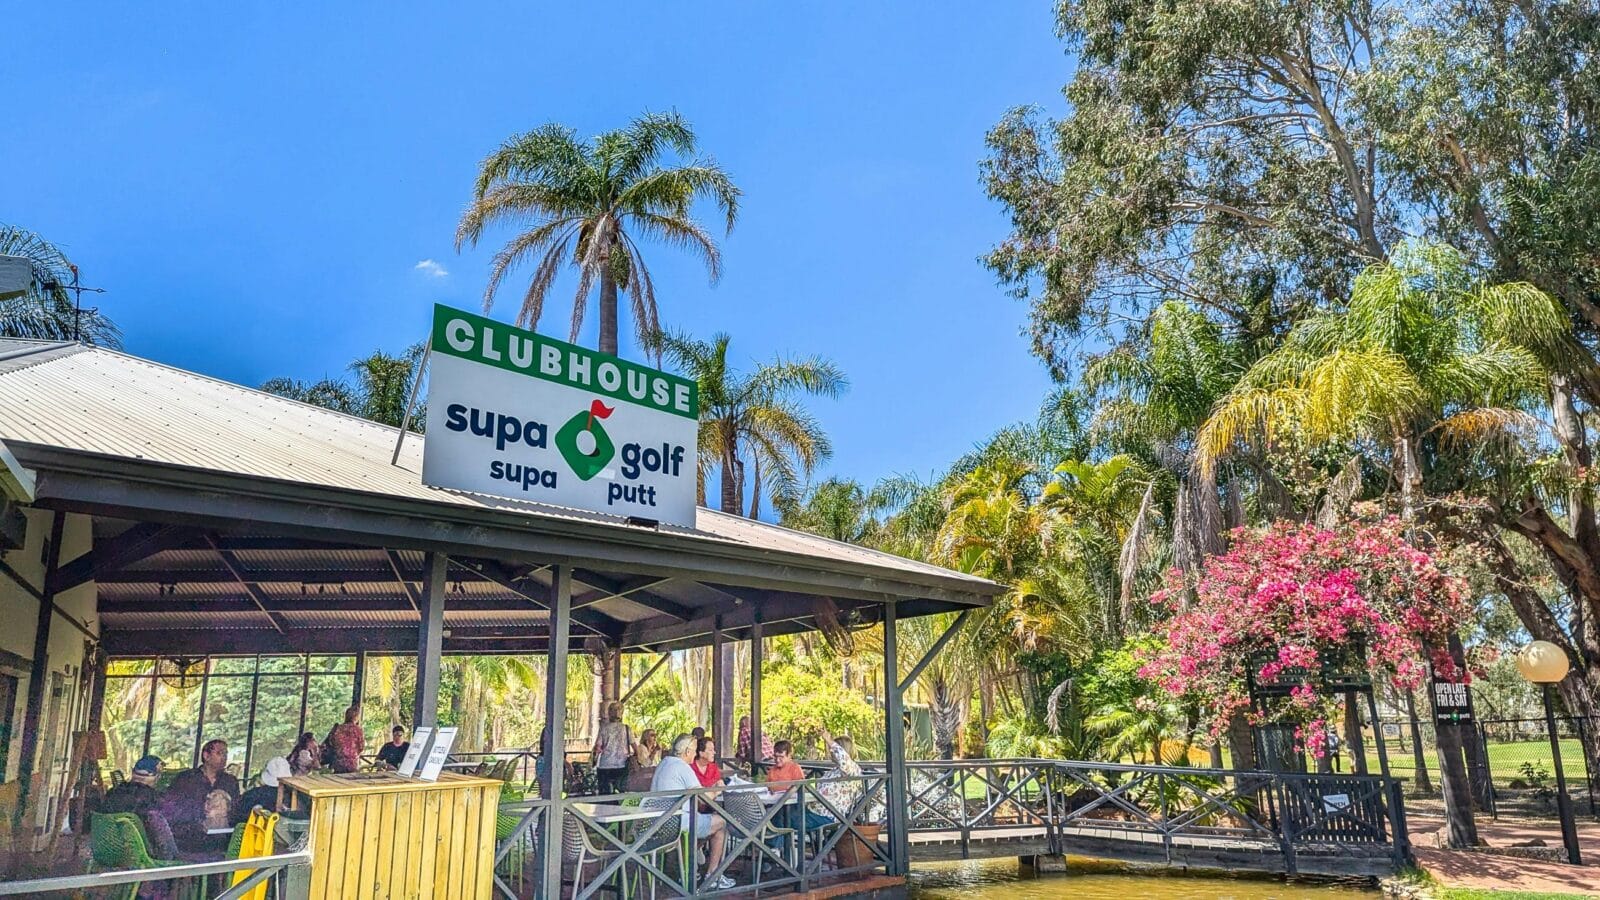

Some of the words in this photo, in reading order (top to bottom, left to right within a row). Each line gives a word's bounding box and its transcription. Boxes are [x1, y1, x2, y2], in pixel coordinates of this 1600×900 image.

[445, 318, 690, 413] CLUBHOUSE
[445, 403, 548, 451] supa
[621, 442, 685, 480] golf
[490, 460, 558, 491] supa
[608, 482, 657, 507] putt
[1435, 683, 1452, 694] OPEN
[1452, 683, 1467, 694] LATE
[1436, 694, 1448, 707] FRI
[1449, 694, 1455, 707] &
[1454, 694, 1468, 707] SAT
